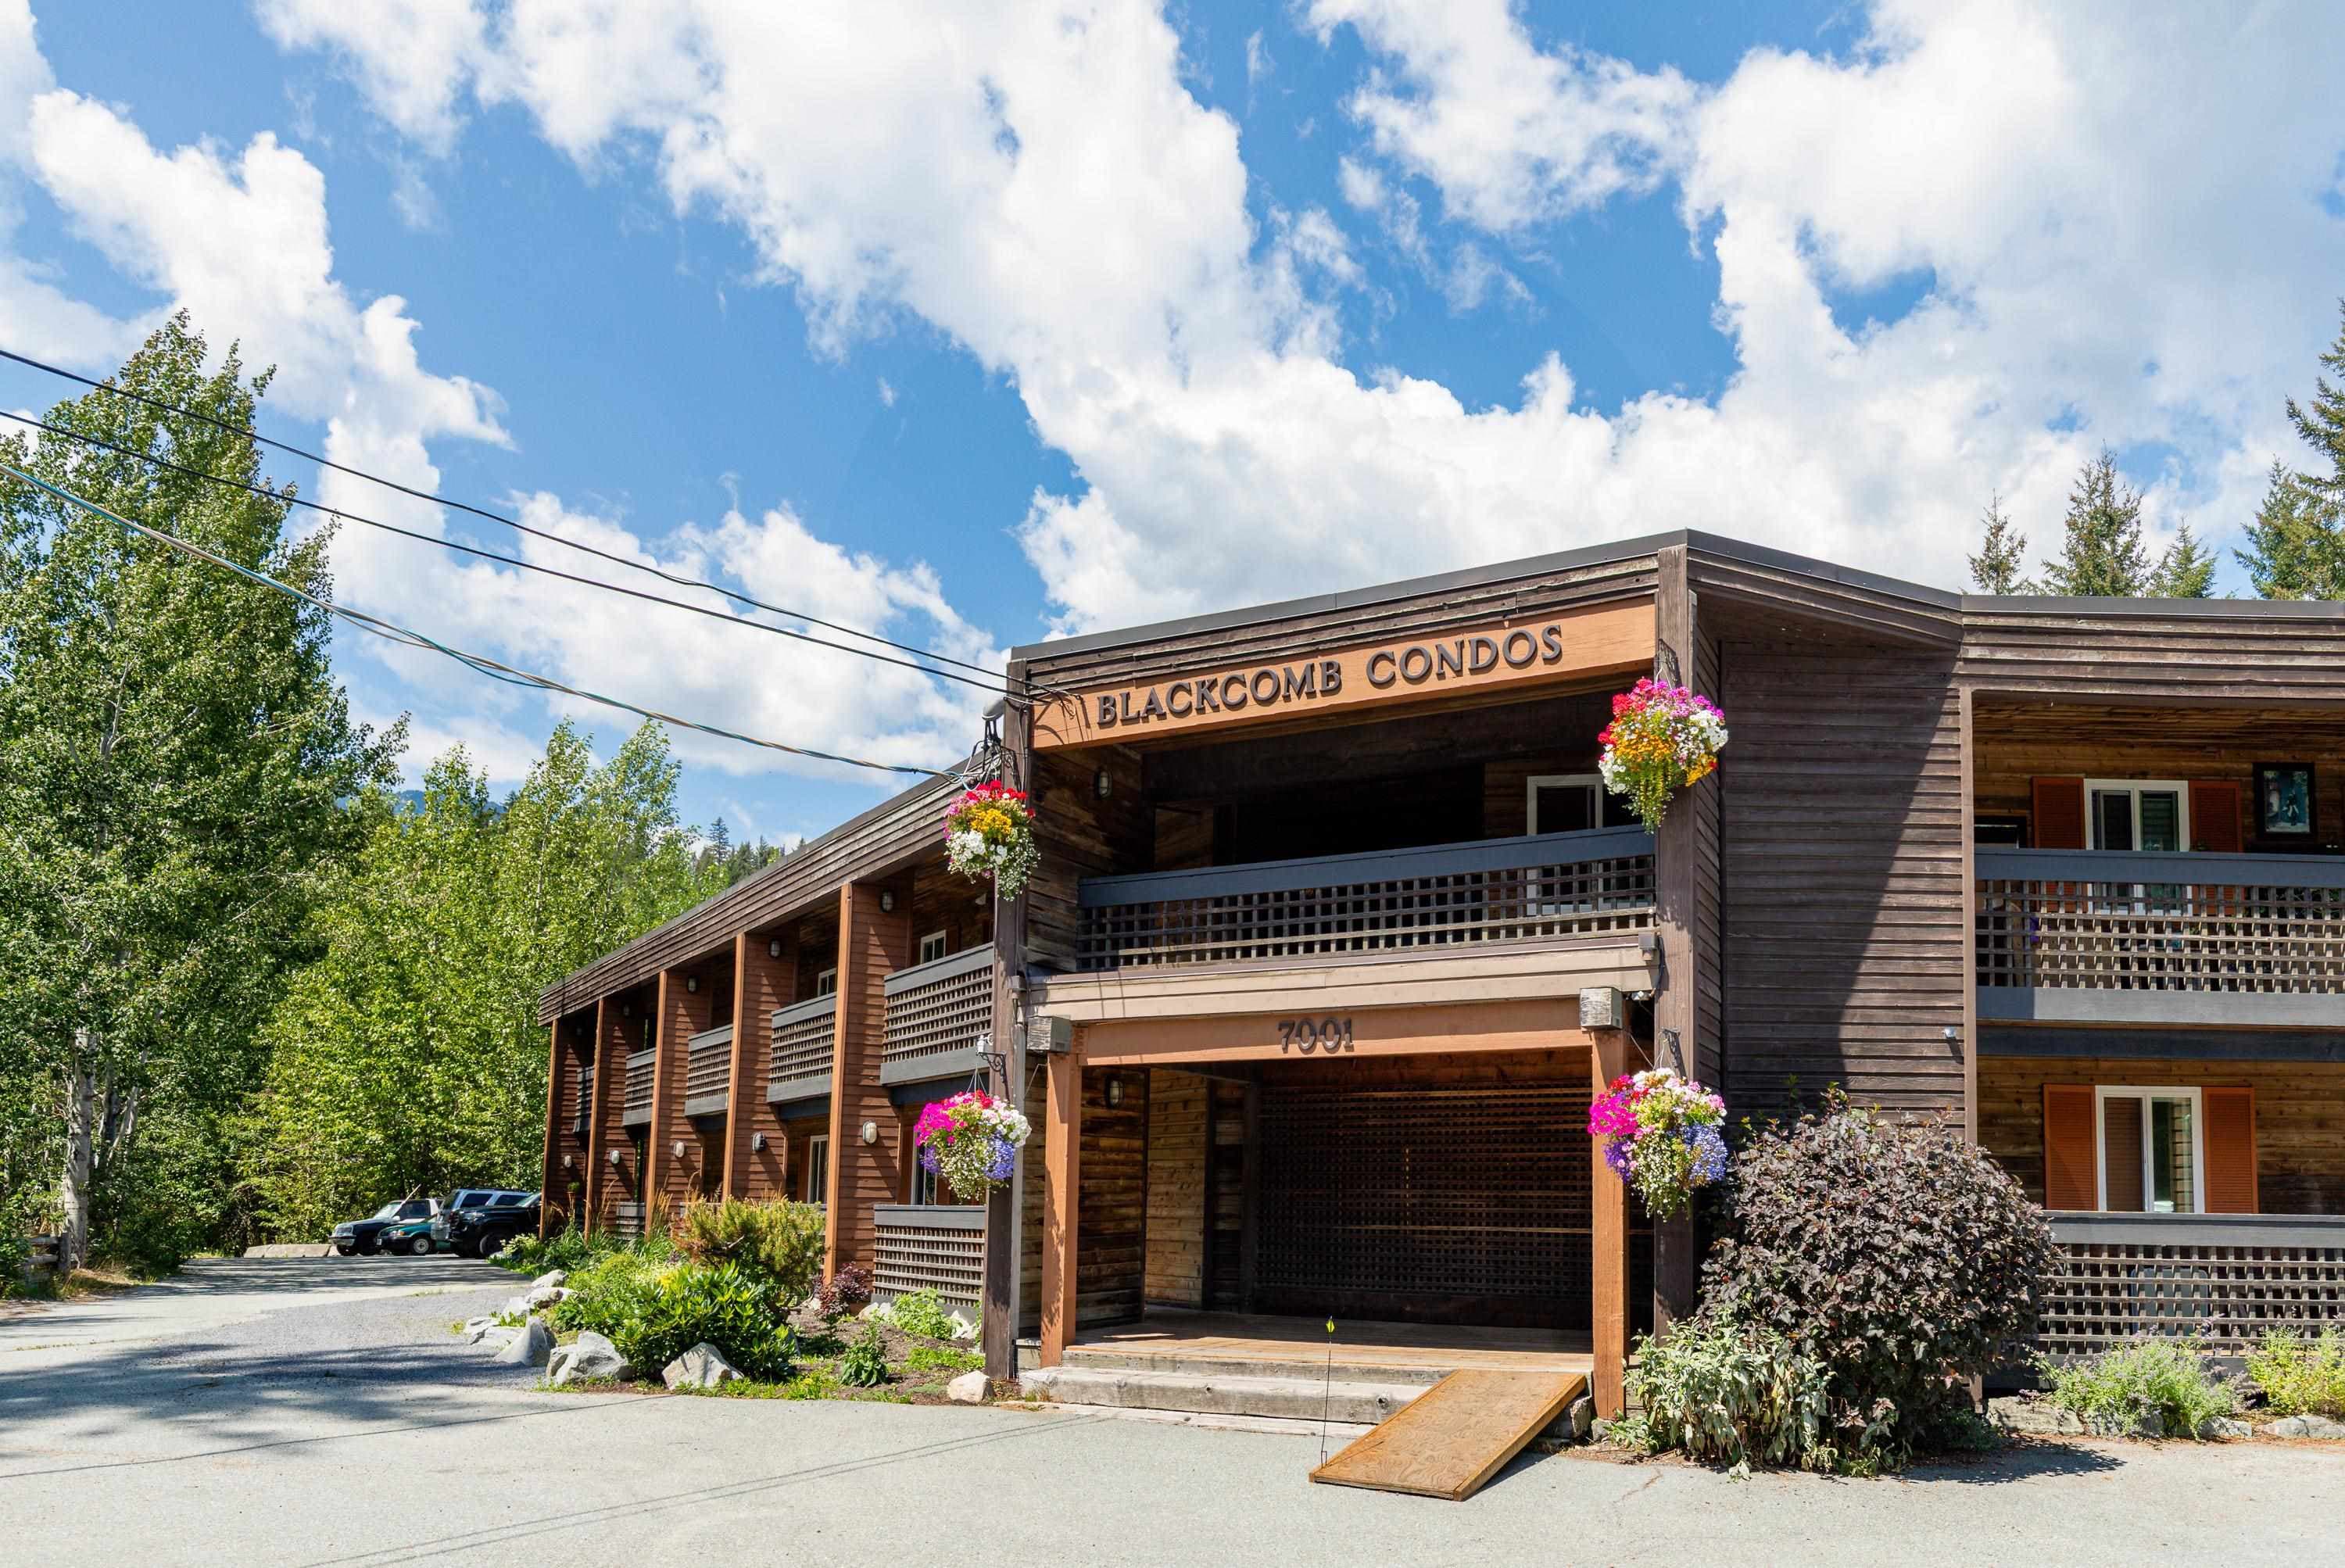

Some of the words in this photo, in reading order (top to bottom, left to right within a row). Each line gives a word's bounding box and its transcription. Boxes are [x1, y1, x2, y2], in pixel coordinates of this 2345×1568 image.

[1097, 660, 1341, 725] BLACKCOMB
[1366, 625, 1562, 685] CONDOS
[1276, 1017, 1354, 1053] 7001
